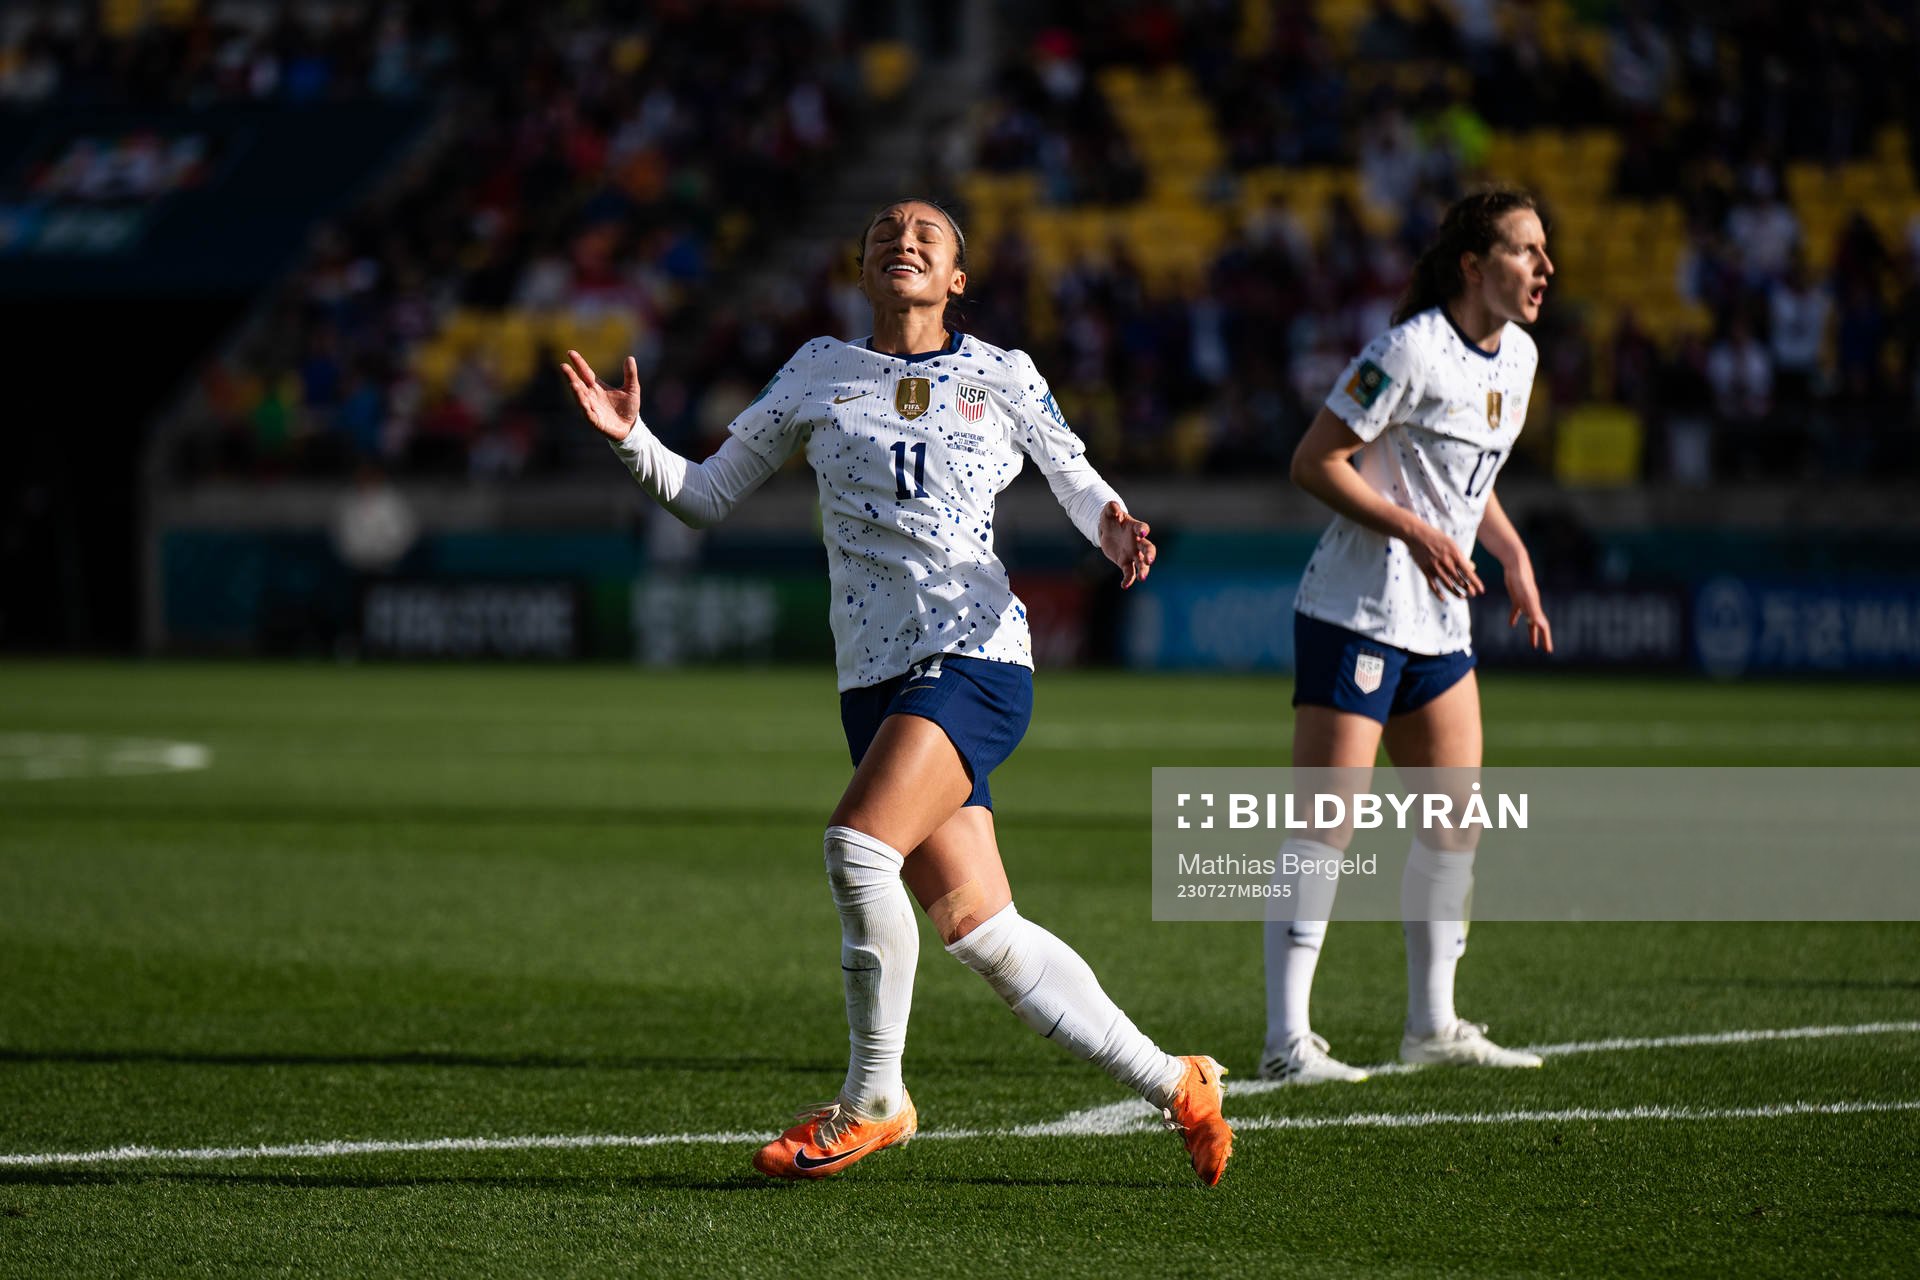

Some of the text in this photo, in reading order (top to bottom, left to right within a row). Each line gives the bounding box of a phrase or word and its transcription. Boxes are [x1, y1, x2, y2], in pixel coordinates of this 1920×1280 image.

[960, 385, 986, 404] USA
[890, 441, 930, 499] 11
[1465, 450, 1501, 497] 17
